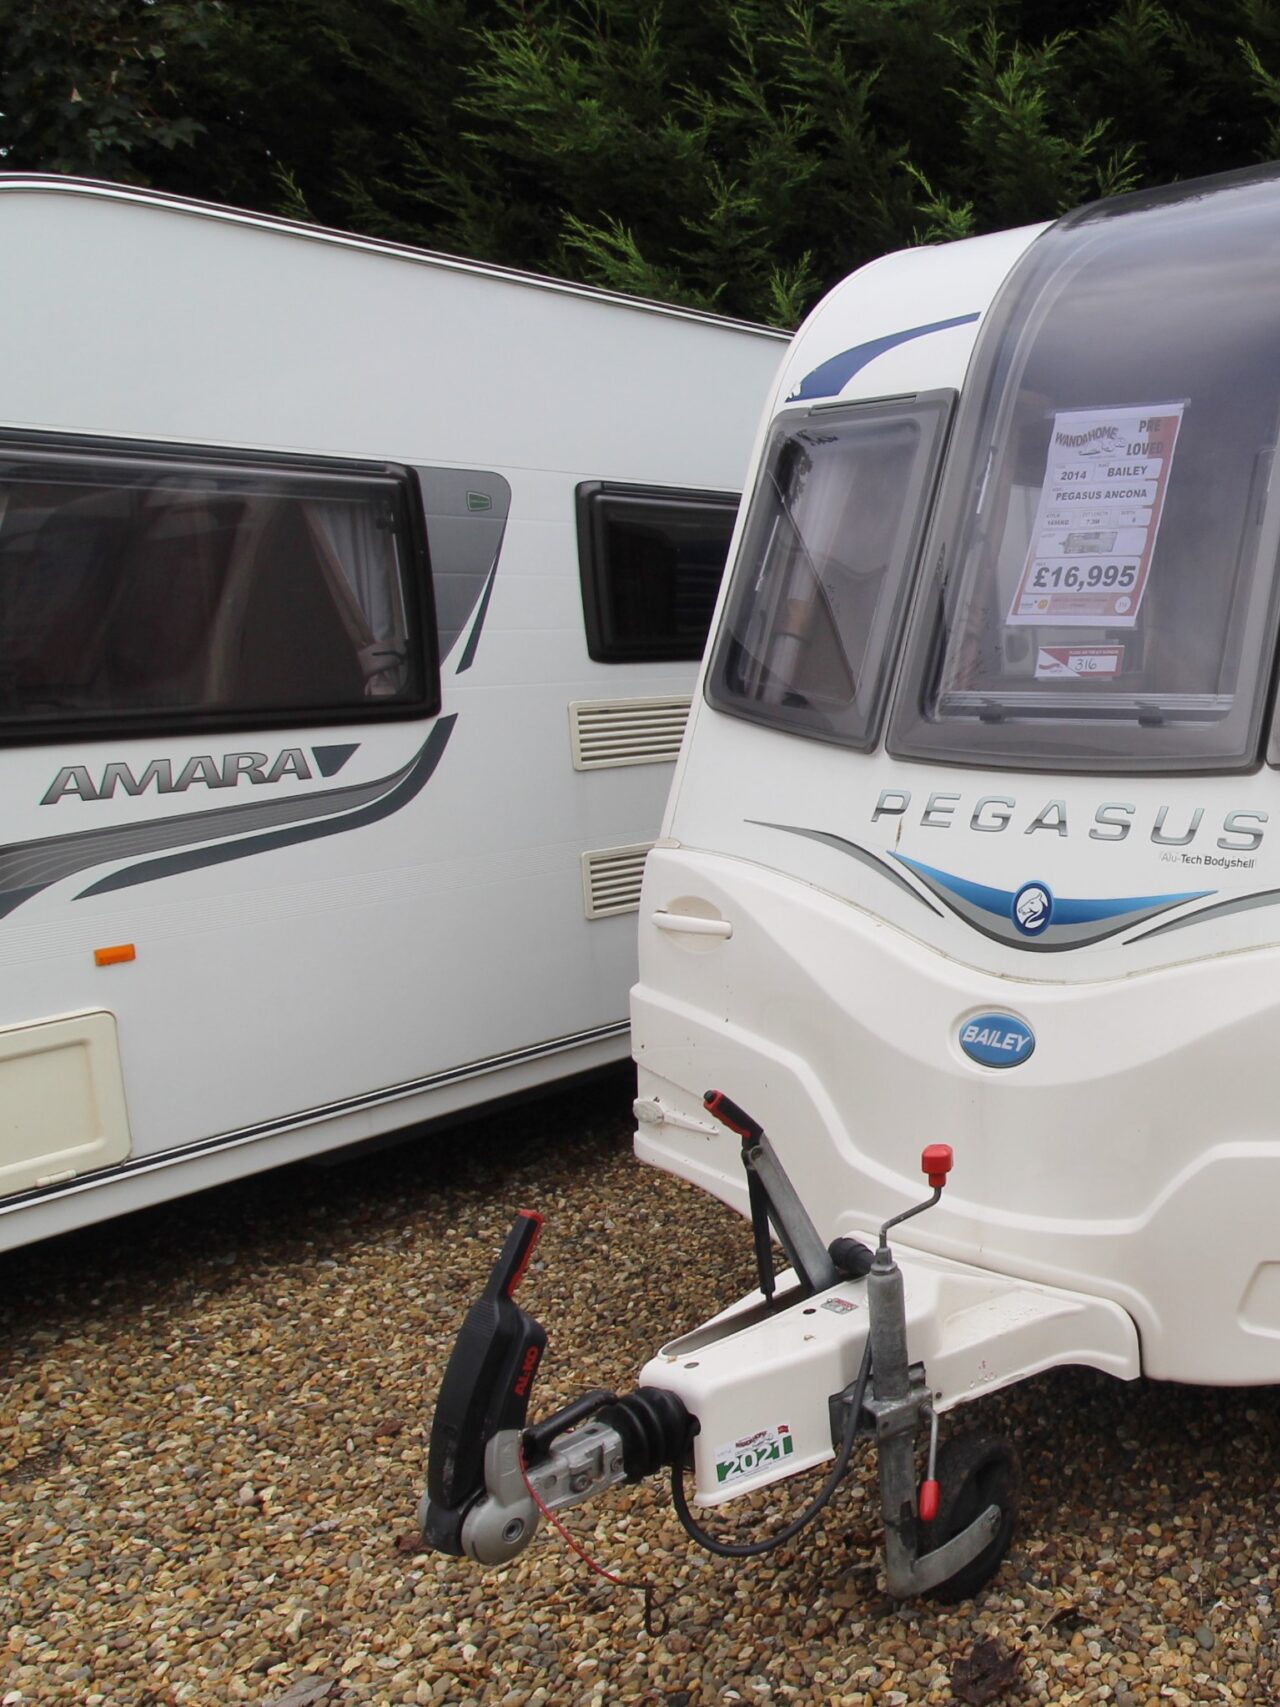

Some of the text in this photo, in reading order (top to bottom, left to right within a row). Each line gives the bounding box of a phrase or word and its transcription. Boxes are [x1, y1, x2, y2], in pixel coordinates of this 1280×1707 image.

[1138, 419, 1161, 433] PRE
[1055, 426, 1119, 448] WANDAHOME
[1126, 442, 1164, 456] LOVED
[1060, 470, 1087, 481] 2014
[1107, 466, 1148, 477] BAILEY
[1055, 489, 1147, 501] PEGASUS ANCONA
[1033, 565, 1136, 592] £16,995
[1074, 658, 1097, 671] 316
[39, 748, 313, 806] AMARA
[871, 788, 1270, 852] PEGASUS
[1204, 855, 1255, 869] Bodyshell
[962, 1025, 1030, 1052] BAILEY
[722, 1437, 786, 1481] 2021
